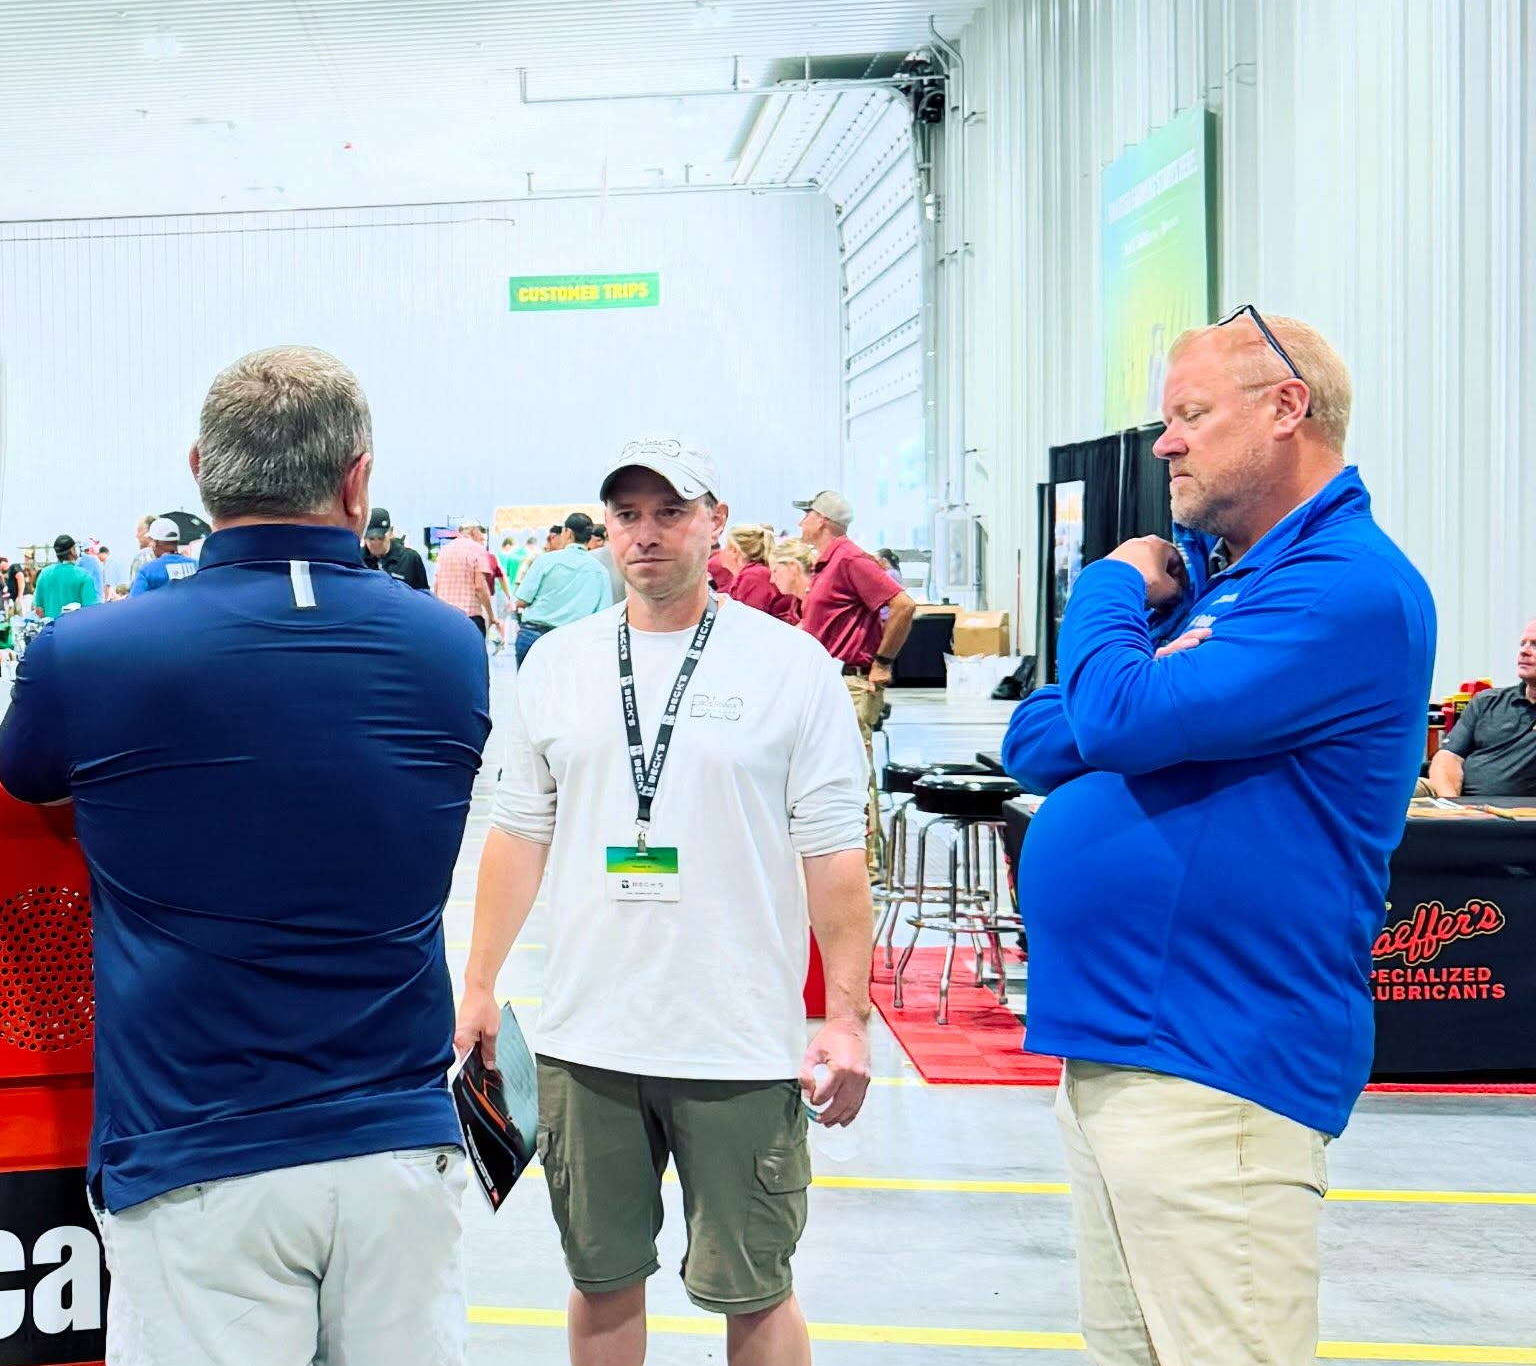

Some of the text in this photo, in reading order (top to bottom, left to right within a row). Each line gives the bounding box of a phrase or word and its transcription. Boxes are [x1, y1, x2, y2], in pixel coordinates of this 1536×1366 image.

[518, 282, 649, 303] CUSTOMER TRIPS
[634, 758, 645, 790] BECK
[1371, 901, 1502, 964] aeffer's
[1370, 967, 1492, 983] ECIALIZED
[1372, 984, 1506, 1001] UBRICANTS
